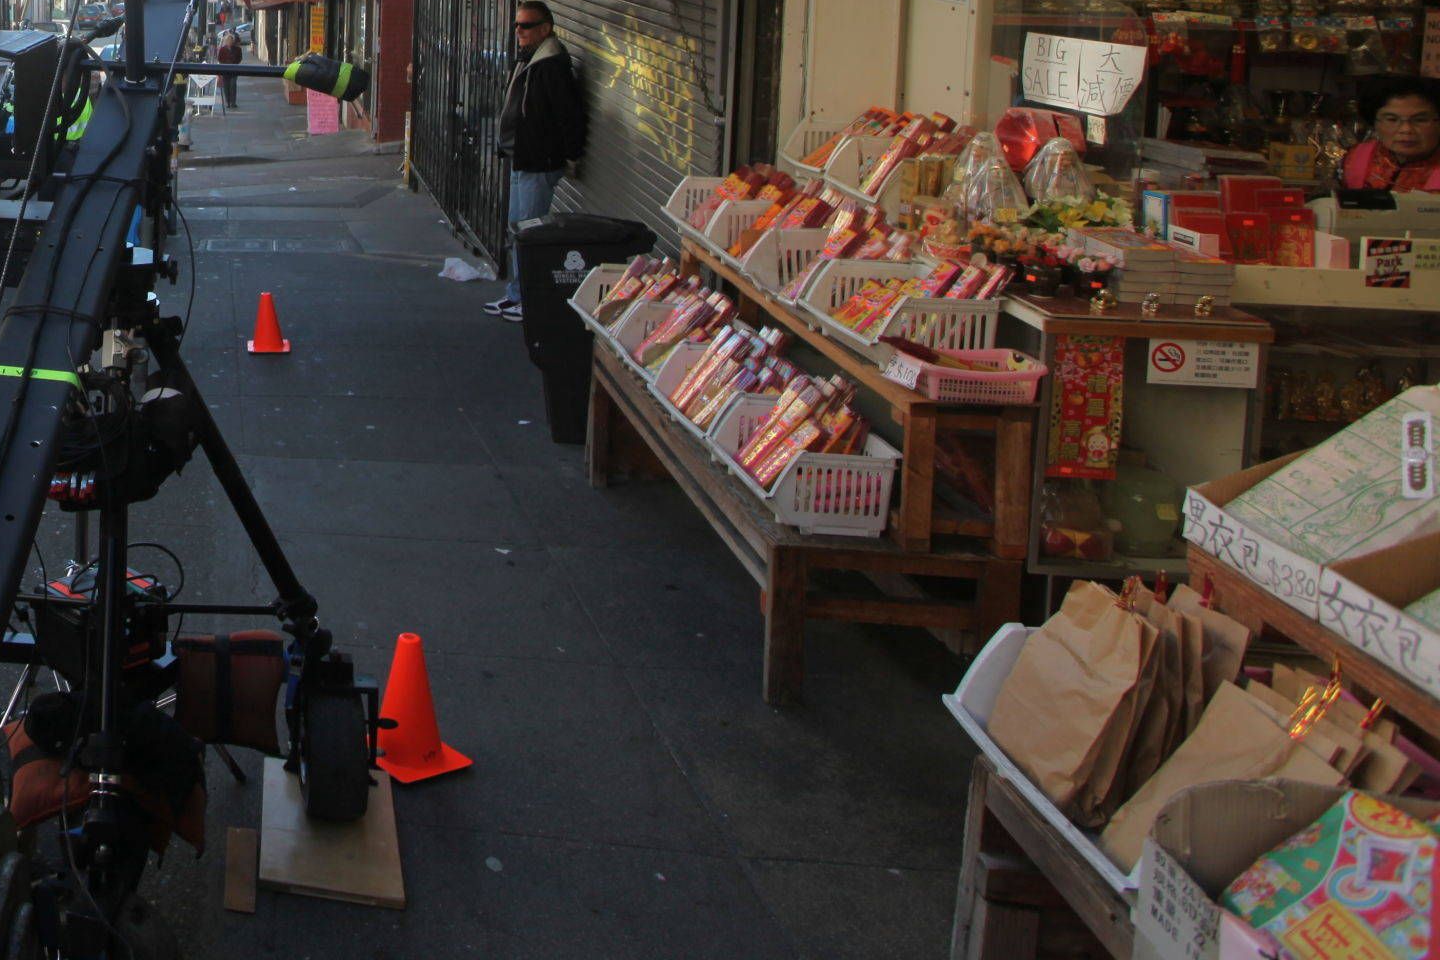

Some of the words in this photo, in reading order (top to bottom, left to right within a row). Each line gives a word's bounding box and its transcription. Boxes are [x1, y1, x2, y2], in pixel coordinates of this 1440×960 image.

[1036, 37, 1067, 61] BIG
[1100, 44, 1123, 72] 大
[1024, 67, 1070, 100] SALE
[1188, 495, 1269, 588] 男衣包
[1265, 556, 1317, 597] $380
[1318, 580, 1434, 685] 女衣包
